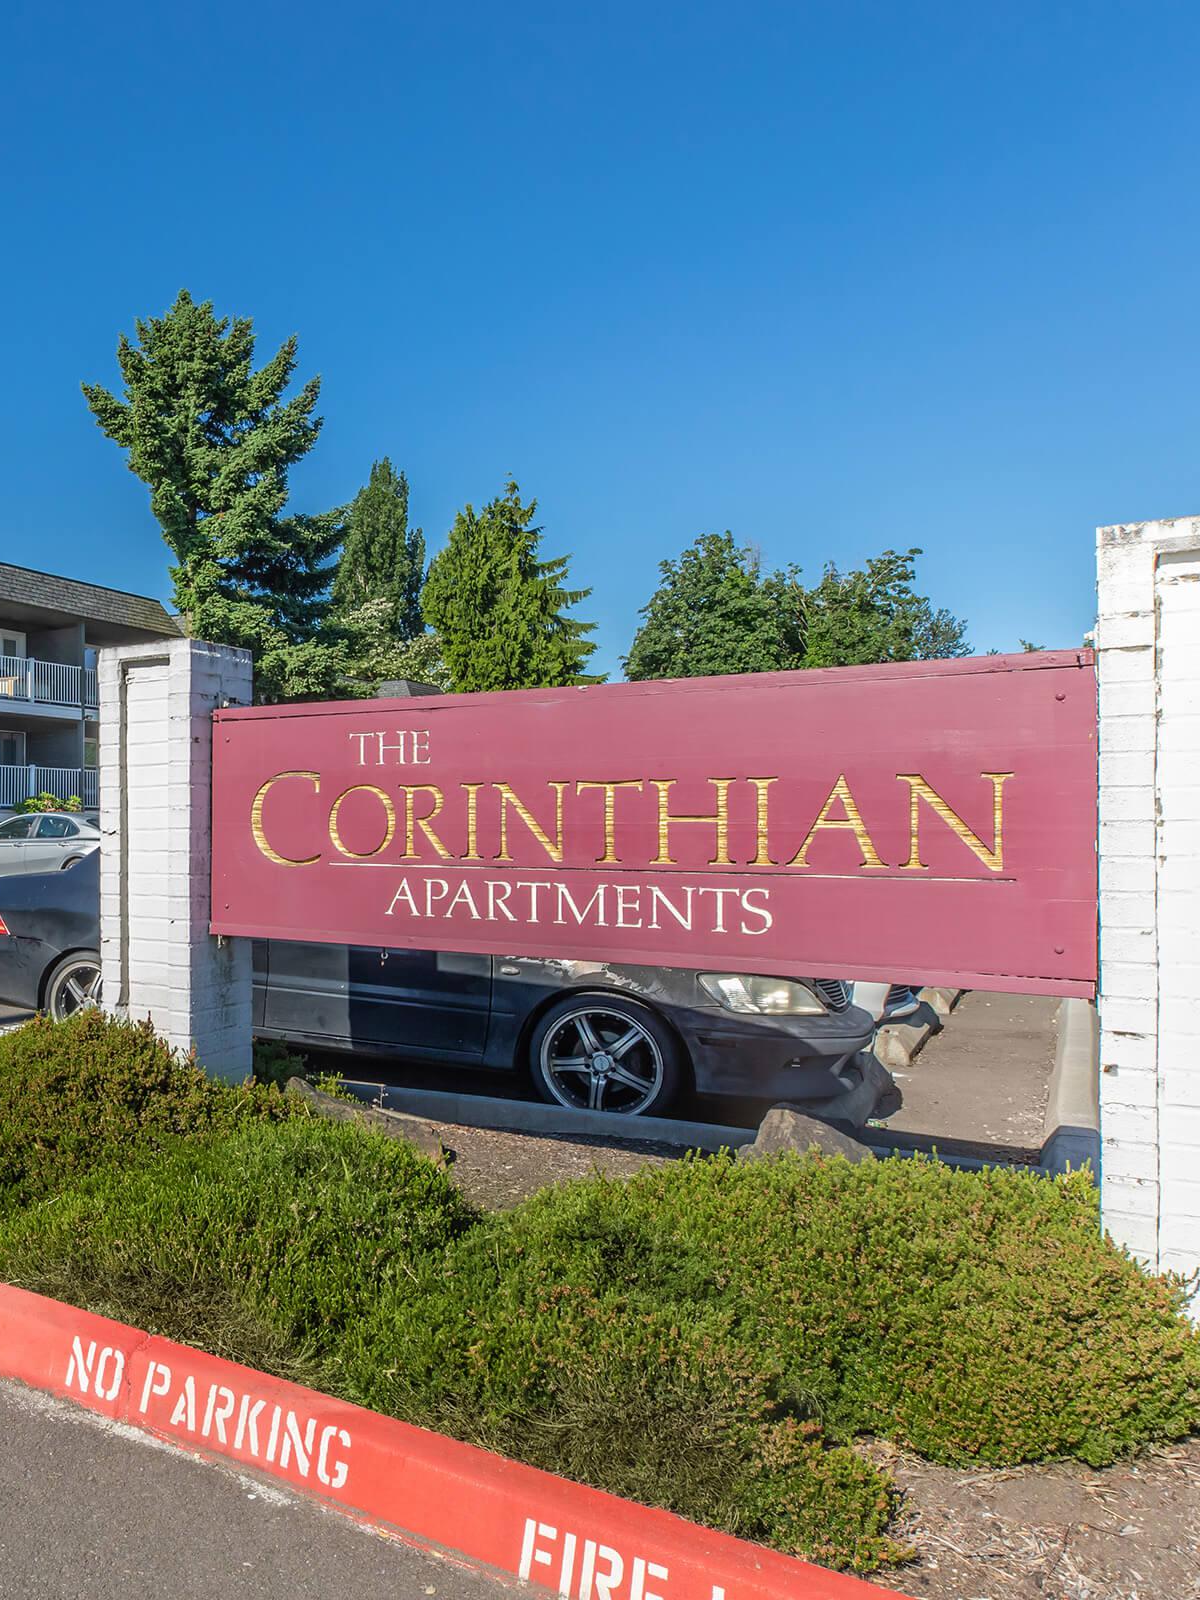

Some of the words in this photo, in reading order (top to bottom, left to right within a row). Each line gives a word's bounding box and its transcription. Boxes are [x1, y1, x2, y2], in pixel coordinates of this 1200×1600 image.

[349, 730, 431, 765] THE
[250, 770, 1014, 872] CORINTHIAN
[385, 877, 773, 935] APARTMENTS
[65, 1336, 125, 1401] NO
[139, 1361, 351, 1488] PARKING
